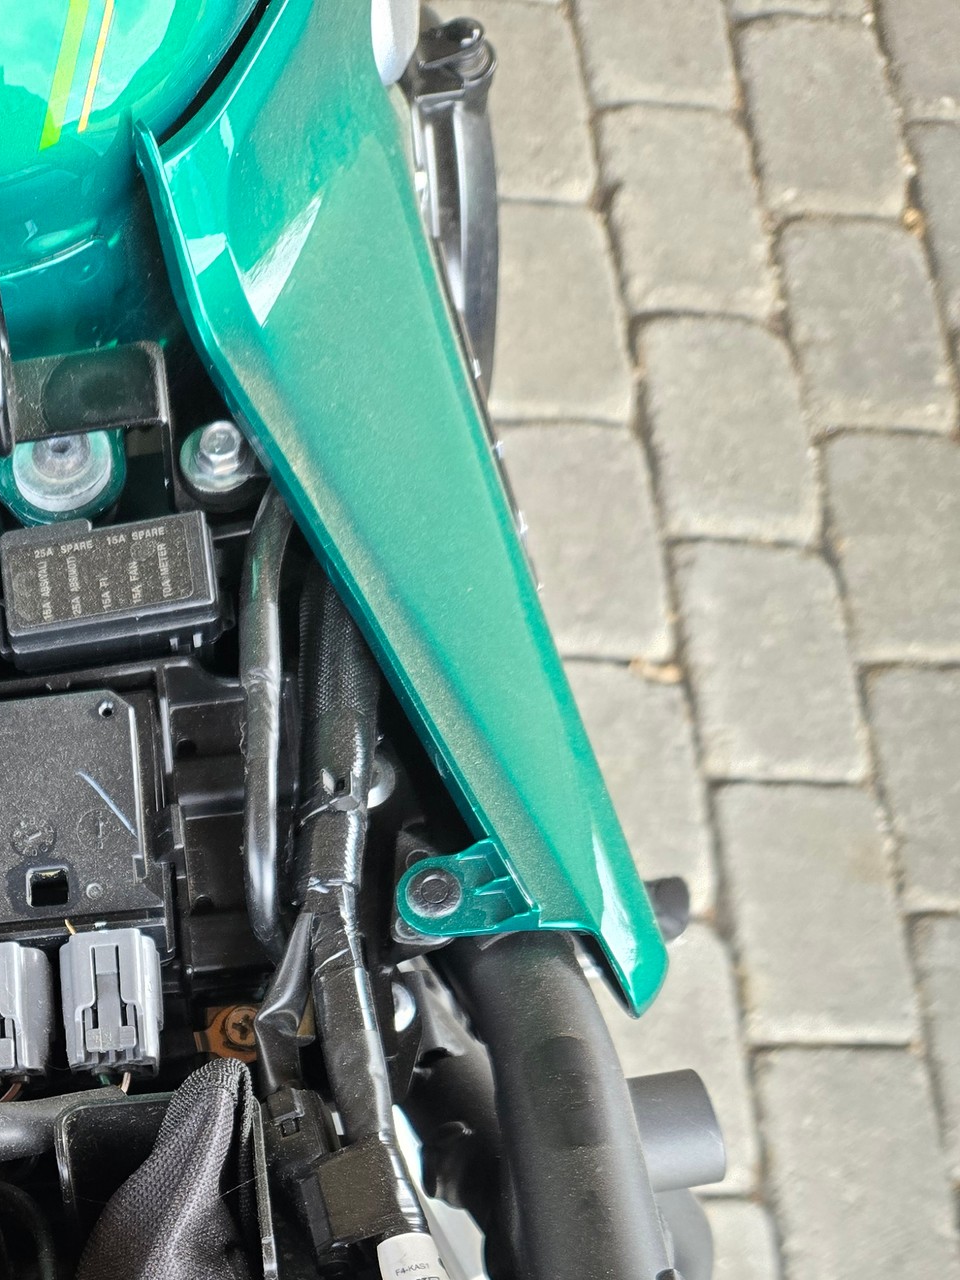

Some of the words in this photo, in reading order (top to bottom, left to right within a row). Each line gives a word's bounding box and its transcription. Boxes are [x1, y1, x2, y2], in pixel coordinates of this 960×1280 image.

[132, 526, 165, 541] SPARE
[34, 547, 53, 559] 25A
[60, 540, 93, 554] SPARE
[129, 561, 139, 582] FAN
[157, 543, 169, 580] METER
[131, 584, 142, 604] 15A
[162, 580, 172, 598] 10A
[71, 596, 81, 618] 25A
[101, 591, 111, 612] 15A
